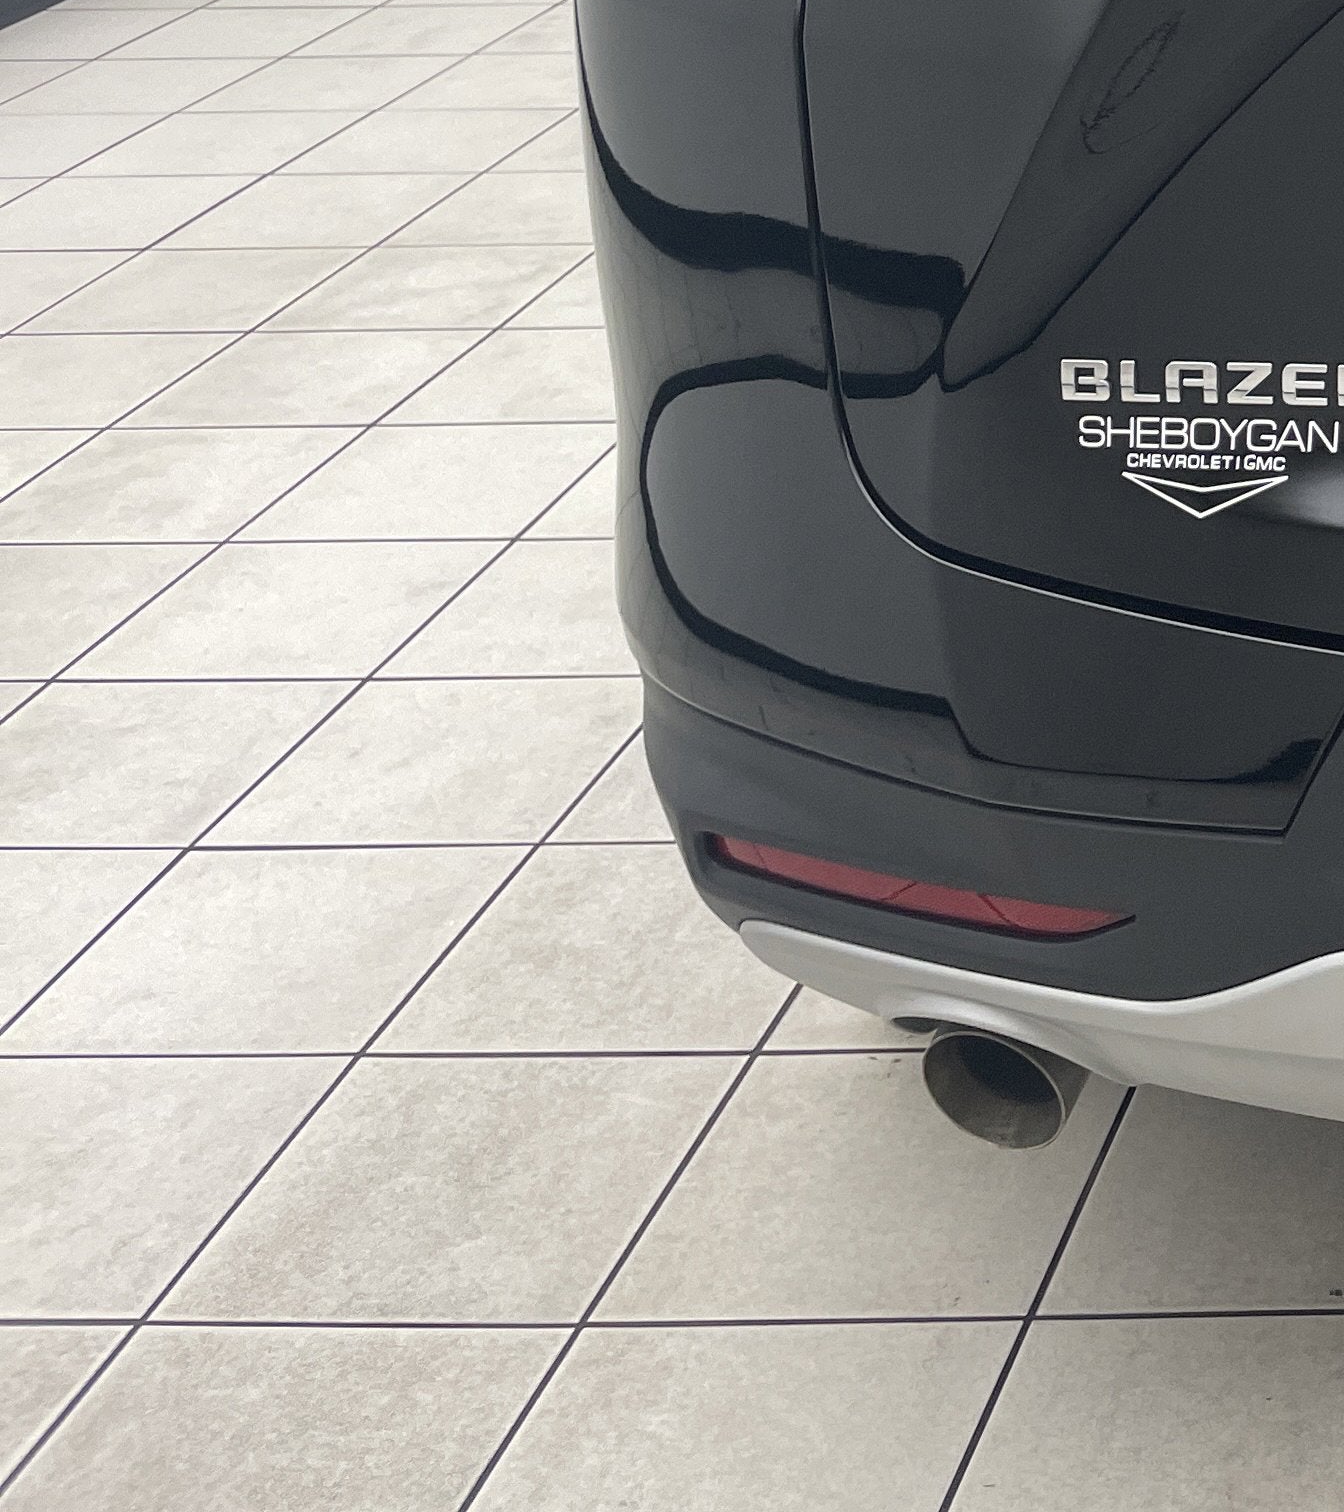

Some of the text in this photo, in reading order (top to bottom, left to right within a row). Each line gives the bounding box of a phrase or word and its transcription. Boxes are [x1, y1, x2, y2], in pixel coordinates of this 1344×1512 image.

[1078, 414, 1339, 454] SHEBOYGAN
[1126, 452, 1287, 471] CHEVROLET GMC
